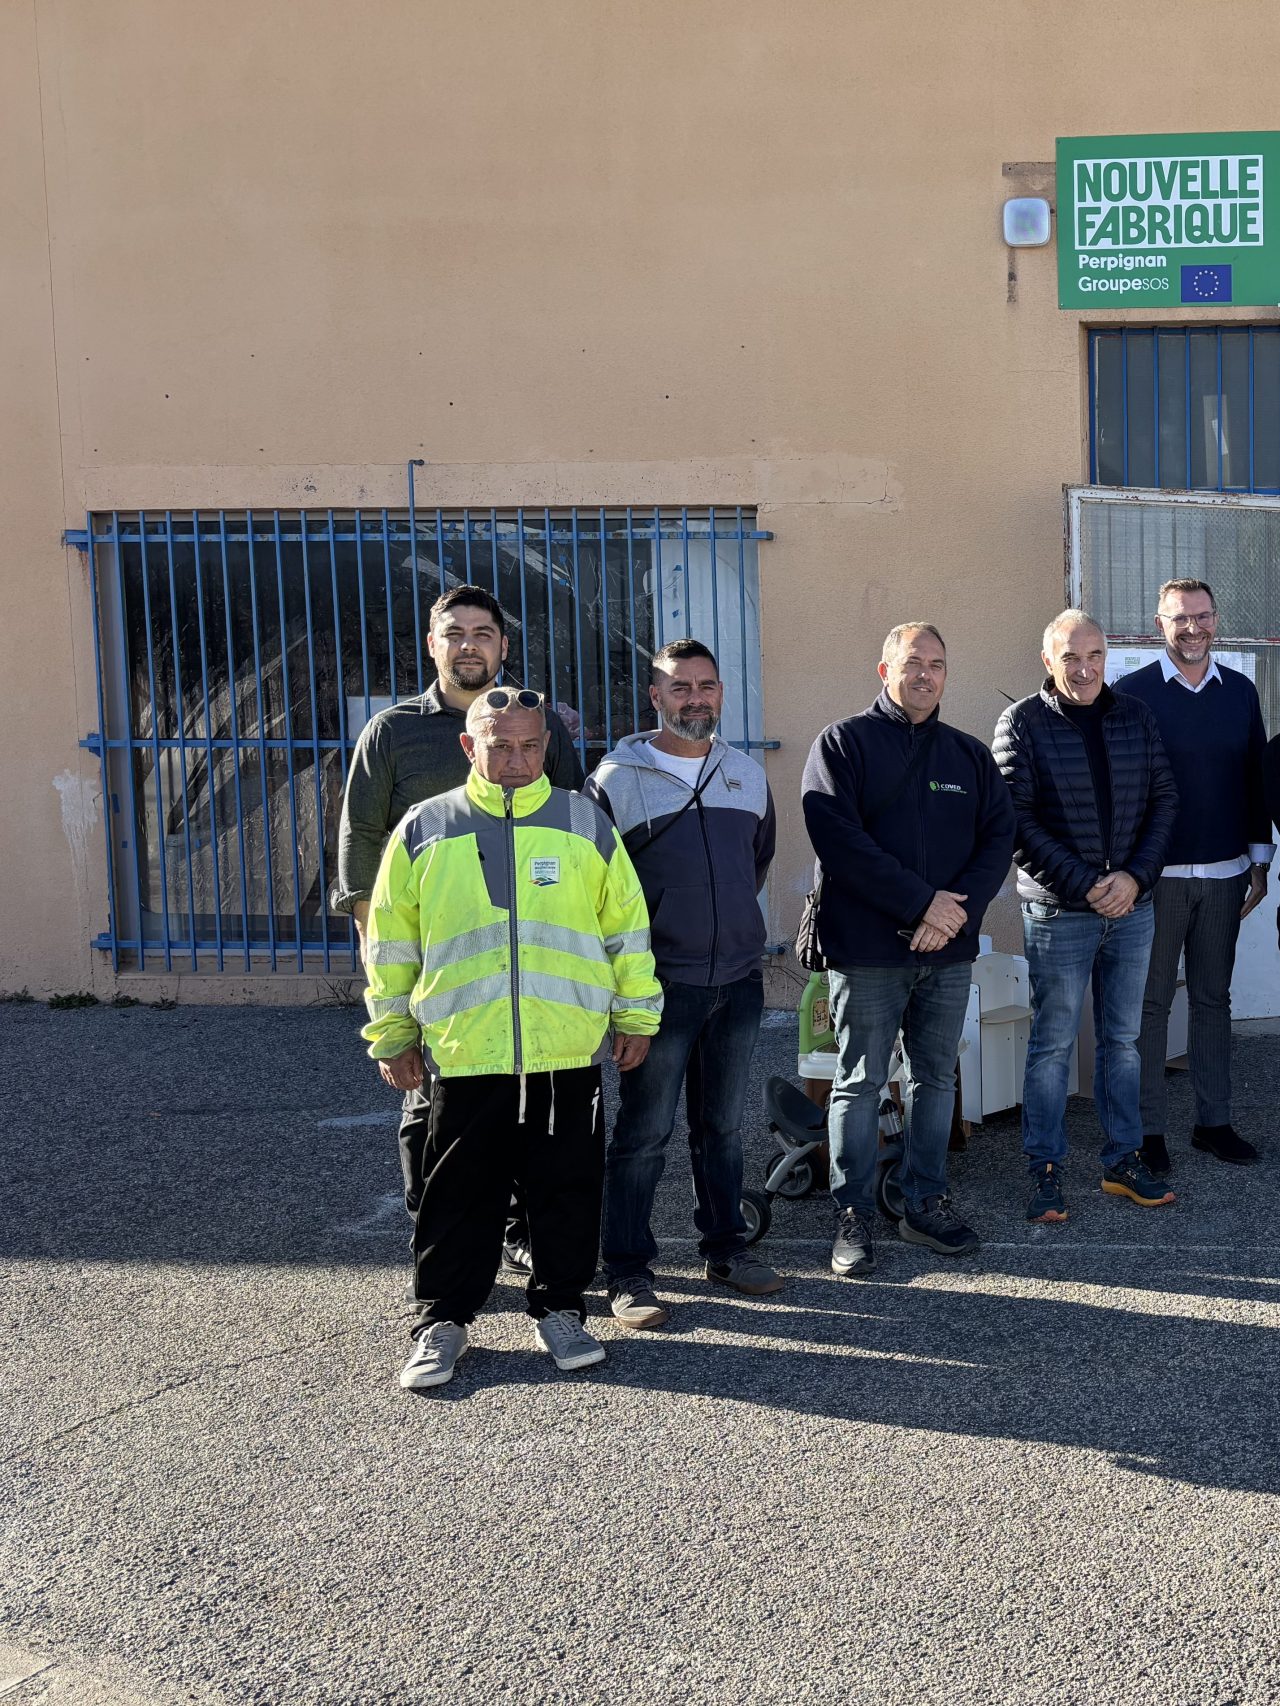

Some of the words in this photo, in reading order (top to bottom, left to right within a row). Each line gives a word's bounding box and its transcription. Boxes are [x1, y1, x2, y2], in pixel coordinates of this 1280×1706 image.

[1077, 158, 1260, 203] NOUVELLE
[1077, 202, 1260, 247] FABRIQUE
[1078, 253, 1167, 272] Perpignan
